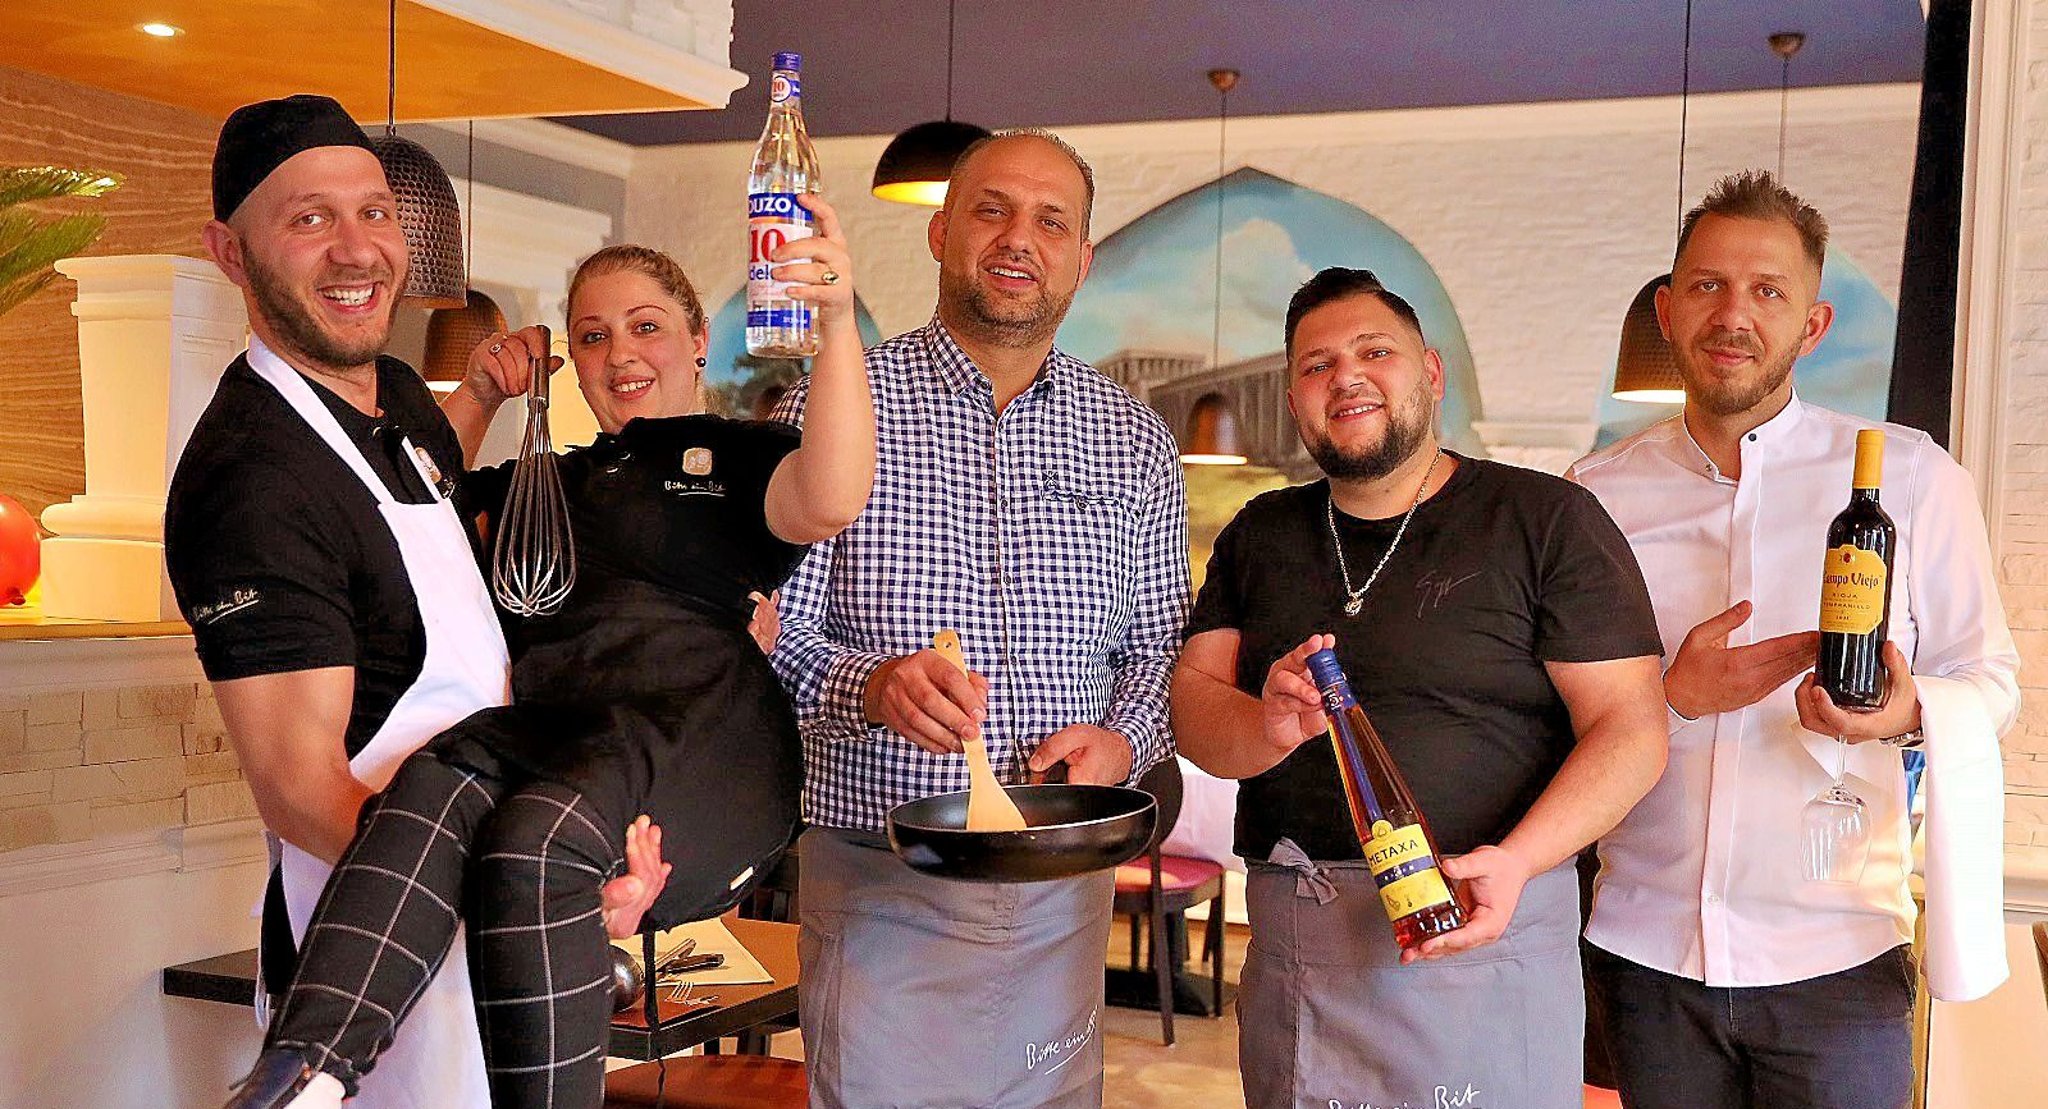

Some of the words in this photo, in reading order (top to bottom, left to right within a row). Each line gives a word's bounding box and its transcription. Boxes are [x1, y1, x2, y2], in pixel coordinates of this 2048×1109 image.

[749, 264, 775, 281] del
[1851, 572, 1880, 590] Viejo
[1368, 839, 1418, 867] METAXA
